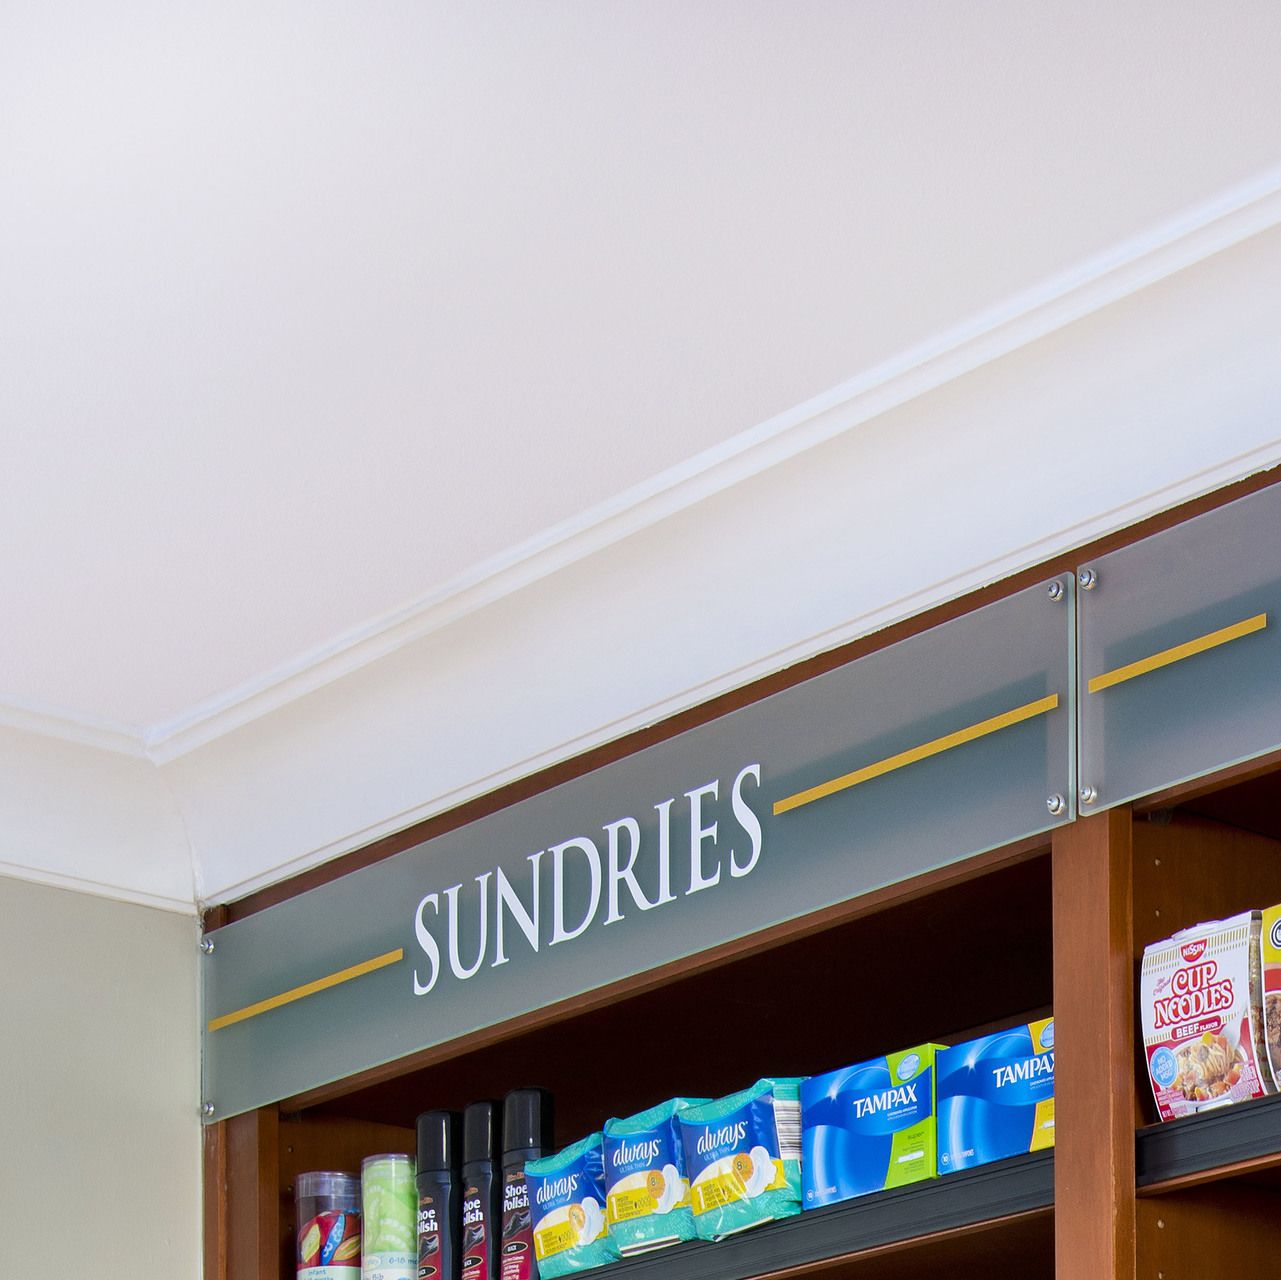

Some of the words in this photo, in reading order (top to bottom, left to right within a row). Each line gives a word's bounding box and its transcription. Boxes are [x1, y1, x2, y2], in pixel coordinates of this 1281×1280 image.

[412, 763, 764, 996] SUNDRIES
[1183, 942, 1205, 957] NISSIN
[1171, 961, 1217, 995] CUP
[1154, 979, 1234, 1029] NOODLES
[1176, 1023, 1200, 1038] BEEF
[1200, 1021, 1218, 1032] FLAVOR
[853, 1083, 918, 1119] TAMPAX
[612, 1138, 659, 1169] always
[697, 1121, 746, 1157] always
[503, 1197, 529, 1213] Polish
[505, 1184, 527, 1198] Shoe
[536, 1172, 578, 1205] always
